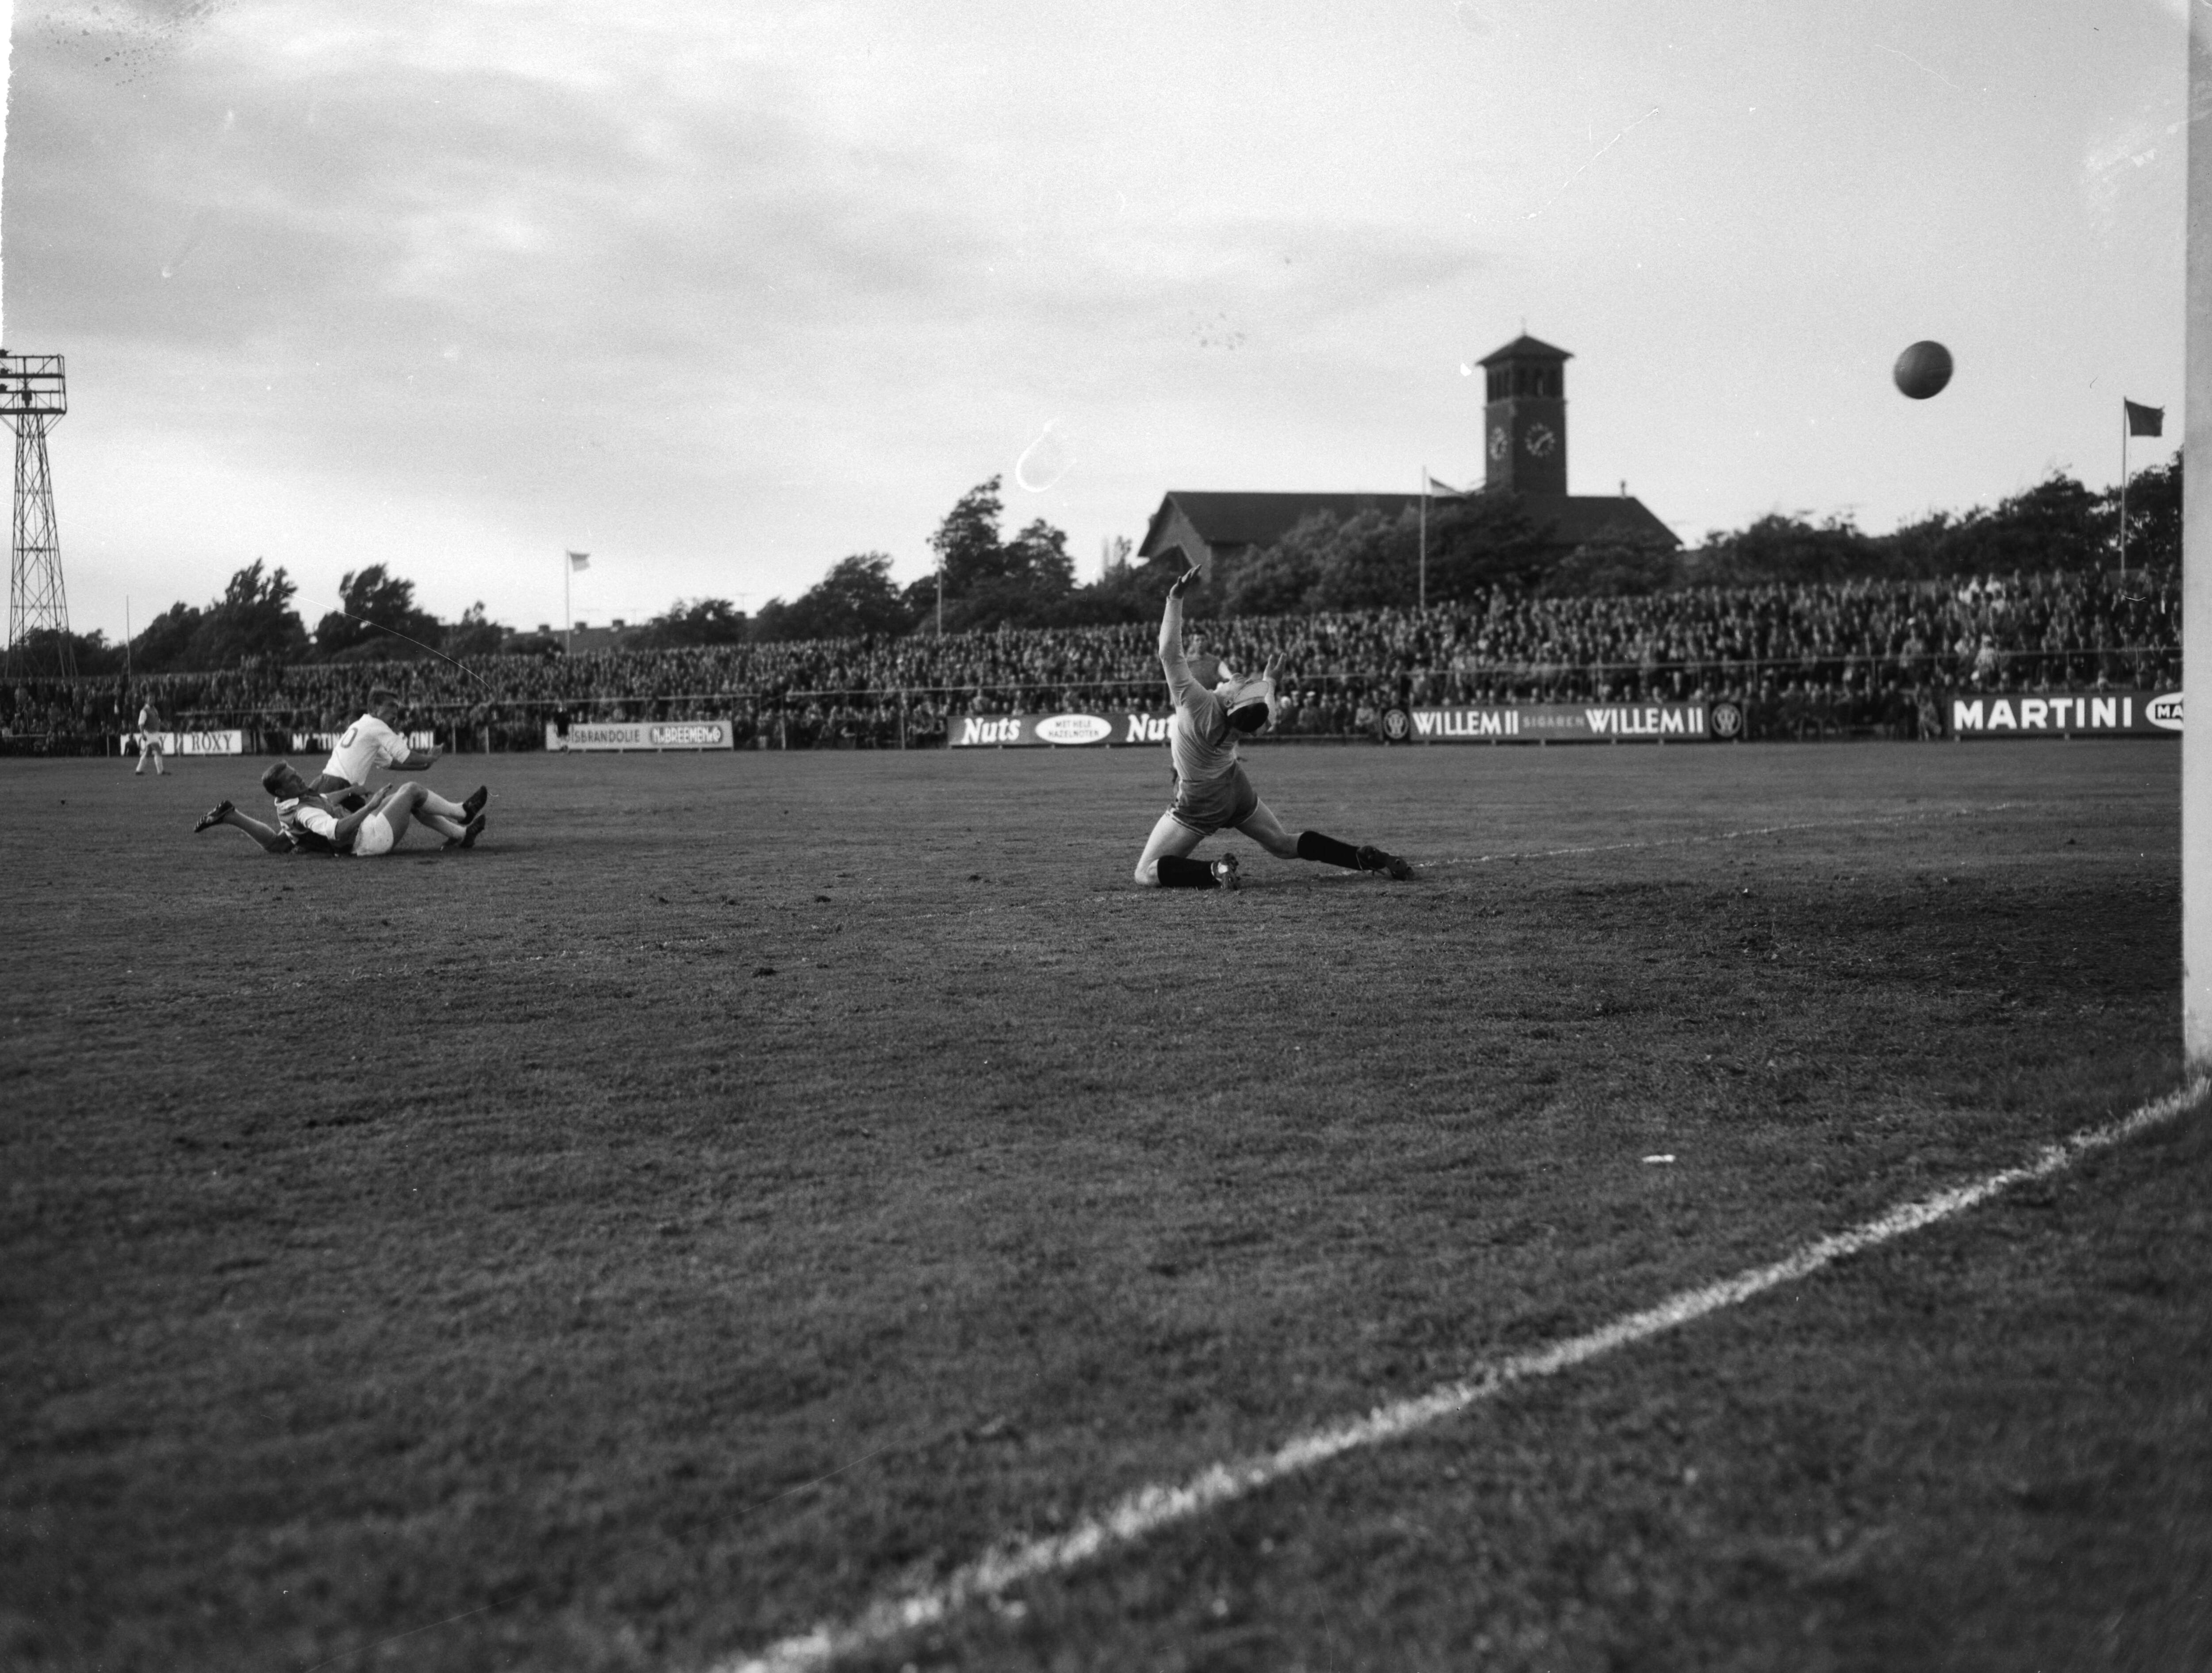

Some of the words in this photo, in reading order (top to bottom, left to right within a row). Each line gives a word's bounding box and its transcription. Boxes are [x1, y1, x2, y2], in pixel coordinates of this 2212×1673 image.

[1412, 711, 1502, 736] WILLEM
[1505, 710, 1519, 735] II
[1585, 707, 1685, 734] WILLEM
[1688, 707, 1704, 734] II
[1954, 697, 2132, 731] MARTINI
[2158, 705, 2183, 718] MA
[192, 731, 231, 751] ROXY
[961, 717, 1021, 745] Nuts
[1048, 729, 1100, 738] HAZELNOTEN
